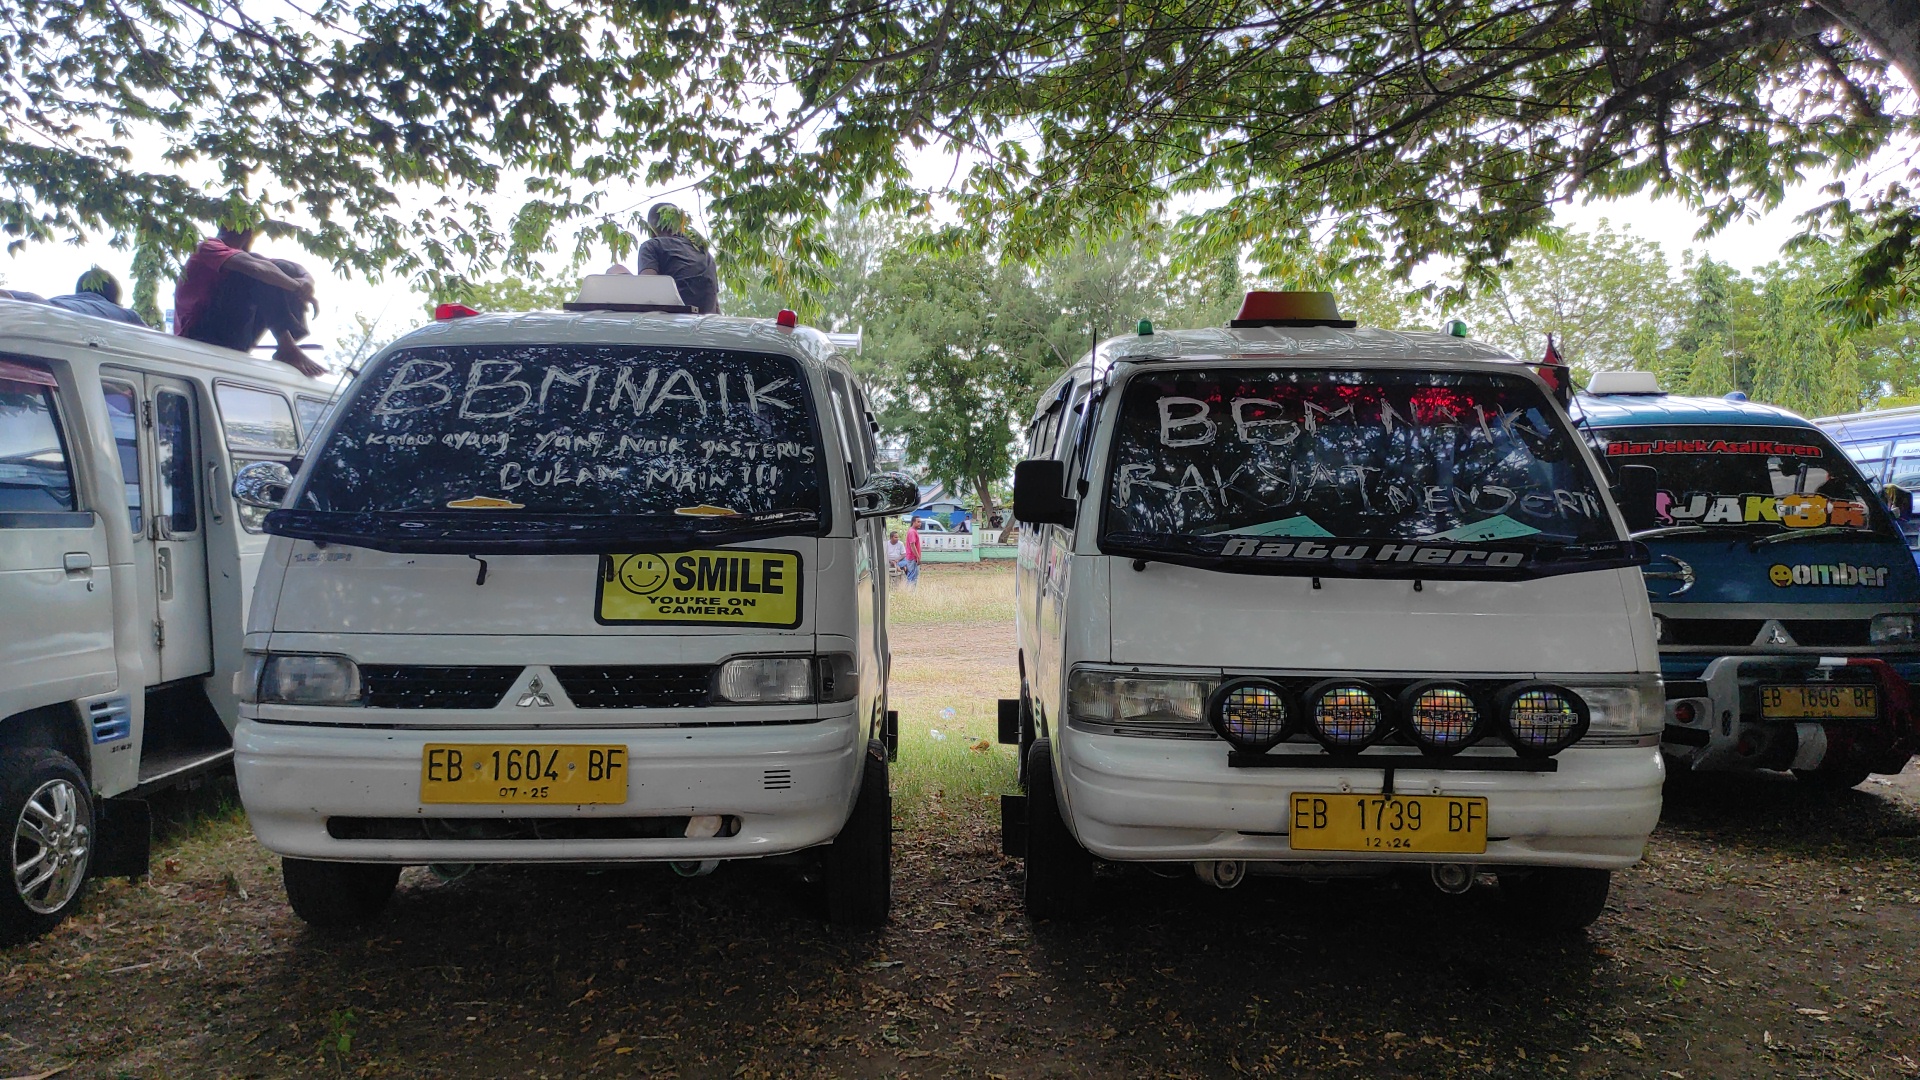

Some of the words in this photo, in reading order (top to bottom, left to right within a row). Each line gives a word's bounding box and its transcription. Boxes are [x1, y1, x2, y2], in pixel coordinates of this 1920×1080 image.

[1652, 440, 1707, 453] Jelek
[1711, 441, 1758, 454] Asal
[1759, 442, 1820, 456] Keren
[1220, 538, 1361, 560] Ratu
[1375, 543, 1524, 568] Hero
[673, 556, 784, 594] SMILE
[647, 596, 721, 606] YOU'RE
[727, 597, 756, 607] ON
[658, 605, 744, 616] CAMERA
[1761, 687, 1782, 708] EB
[1799, 687, 1840, 708] 1696
[428, 749, 463, 782] EB
[492, 750, 559, 782] 1604
[588, 749, 625, 781] BF
[1295, 798, 1327, 829] EB
[1357, 799, 1421, 830] 1739
[1449, 801, 1482, 832] BF
